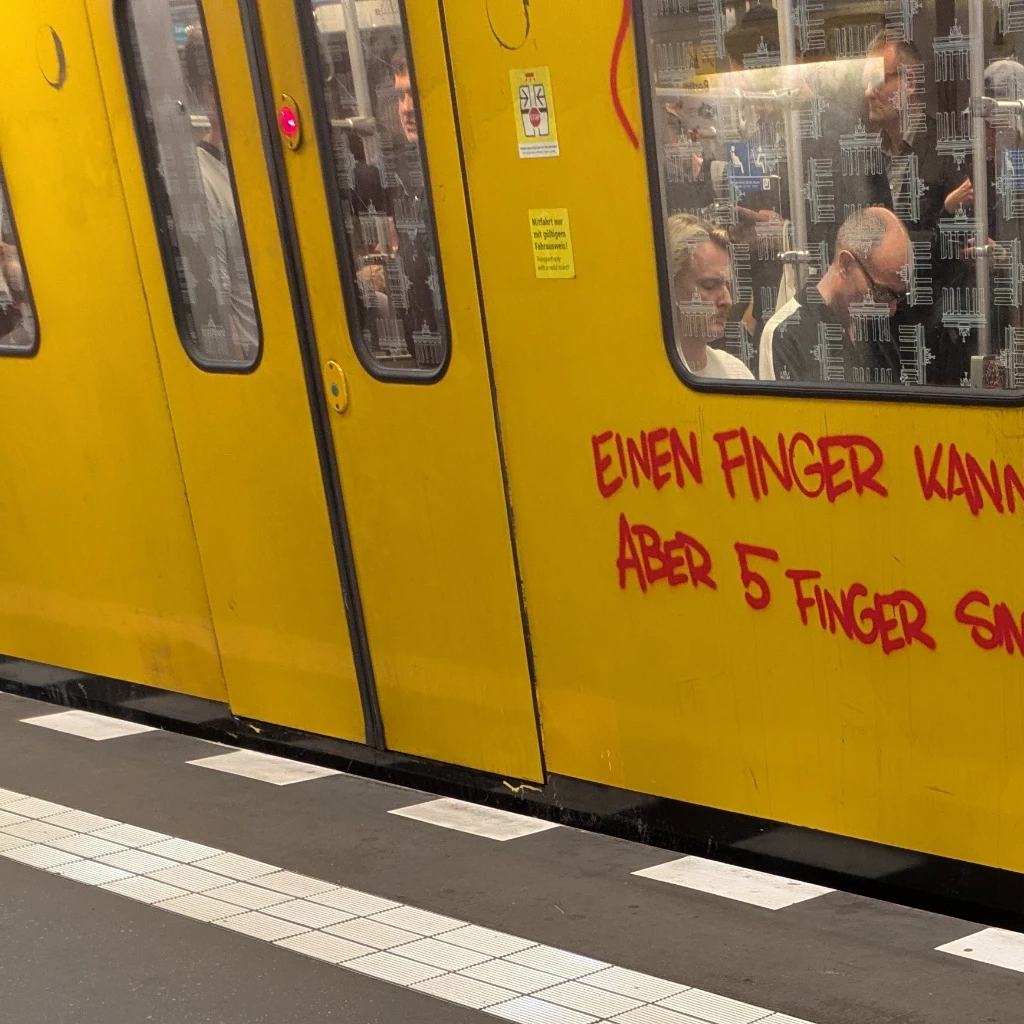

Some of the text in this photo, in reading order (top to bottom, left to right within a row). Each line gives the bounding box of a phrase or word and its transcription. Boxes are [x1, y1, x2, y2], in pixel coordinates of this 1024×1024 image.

[533, 230, 542, 238] mit
[535, 241, 568, 250] Fahrausweis!
[591, 427, 703, 499] EINEN
[712, 426, 889, 504] FINGER
[615, 512, 718, 595] ABER
[733, 541, 780, 611] 5
[784, 568, 937, 656] FINGER
